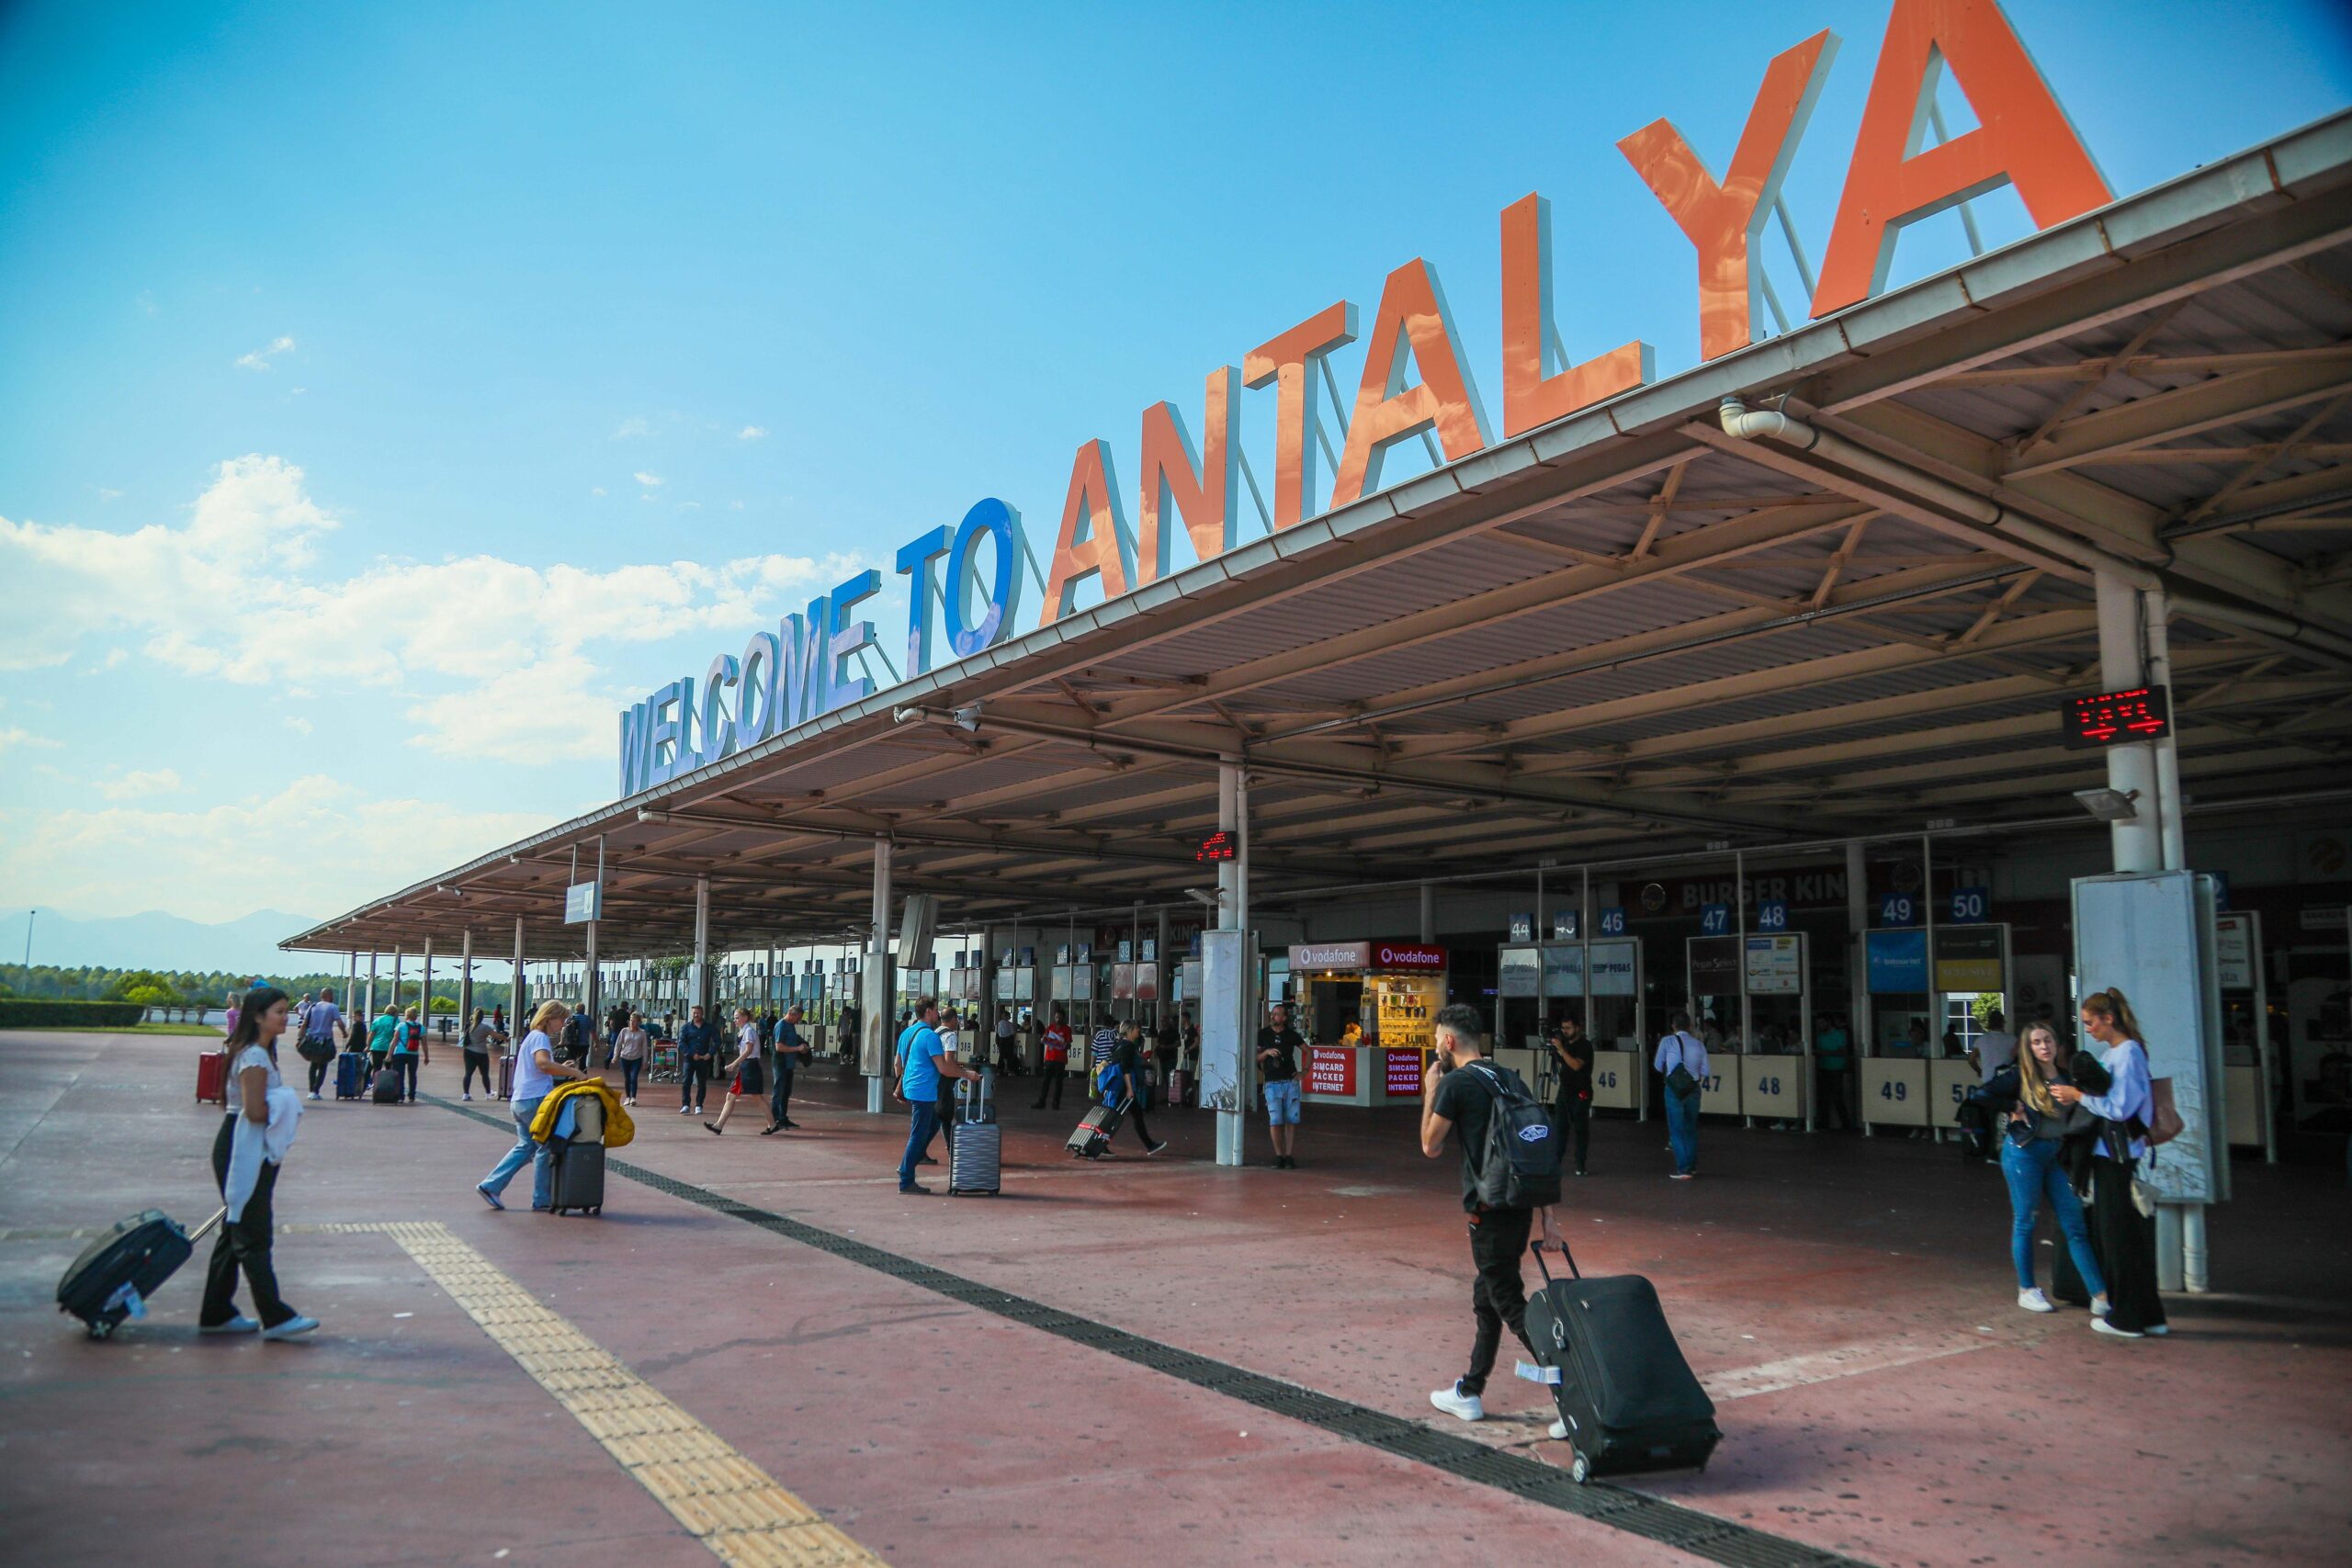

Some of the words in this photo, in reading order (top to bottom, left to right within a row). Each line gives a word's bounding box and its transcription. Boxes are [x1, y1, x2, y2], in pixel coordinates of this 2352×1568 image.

[619, 570, 880, 797] WELCOME
[897, 497, 1023, 680] TO
[1039, 0, 2114, 626] ANTALYA
[1682, 877, 1787, 908] BURGER
[1794, 874, 1848, 902] KIN
[1883, 898, 1911, 921] 49
[1953, 894, 1983, 918] 50
[1602, 912, 1623, 932] 46
[1703, 909, 1726, 931] 47
[1759, 906, 1785, 926] 48
[1123, 927, 1159, 942] BURGE
[1511, 923, 1530, 937] 44
[1120, 945, 1129, 958] 39
[1143, 943, 1155, 956] 40
[1312, 948, 1356, 963] vodafone
[1393, 951, 1440, 964] vodafone
[1609, 963, 1631, 974] PEGAS
[1319, 1050, 1345, 1060] vodafone
[1395, 1054, 1419, 1062] vodafone
[1313, 1062, 1344, 1072] SIMCARD
[1313, 1072, 1344, 1081] PACKED
[1598, 1072, 1616, 1089] 46
[1702, 1076, 1722, 1092] 47
[1313, 1082, 1344, 1092] INTERNET
[1758, 1077, 1781, 1096] 48
[1881, 1082, 1906, 1101] 49
